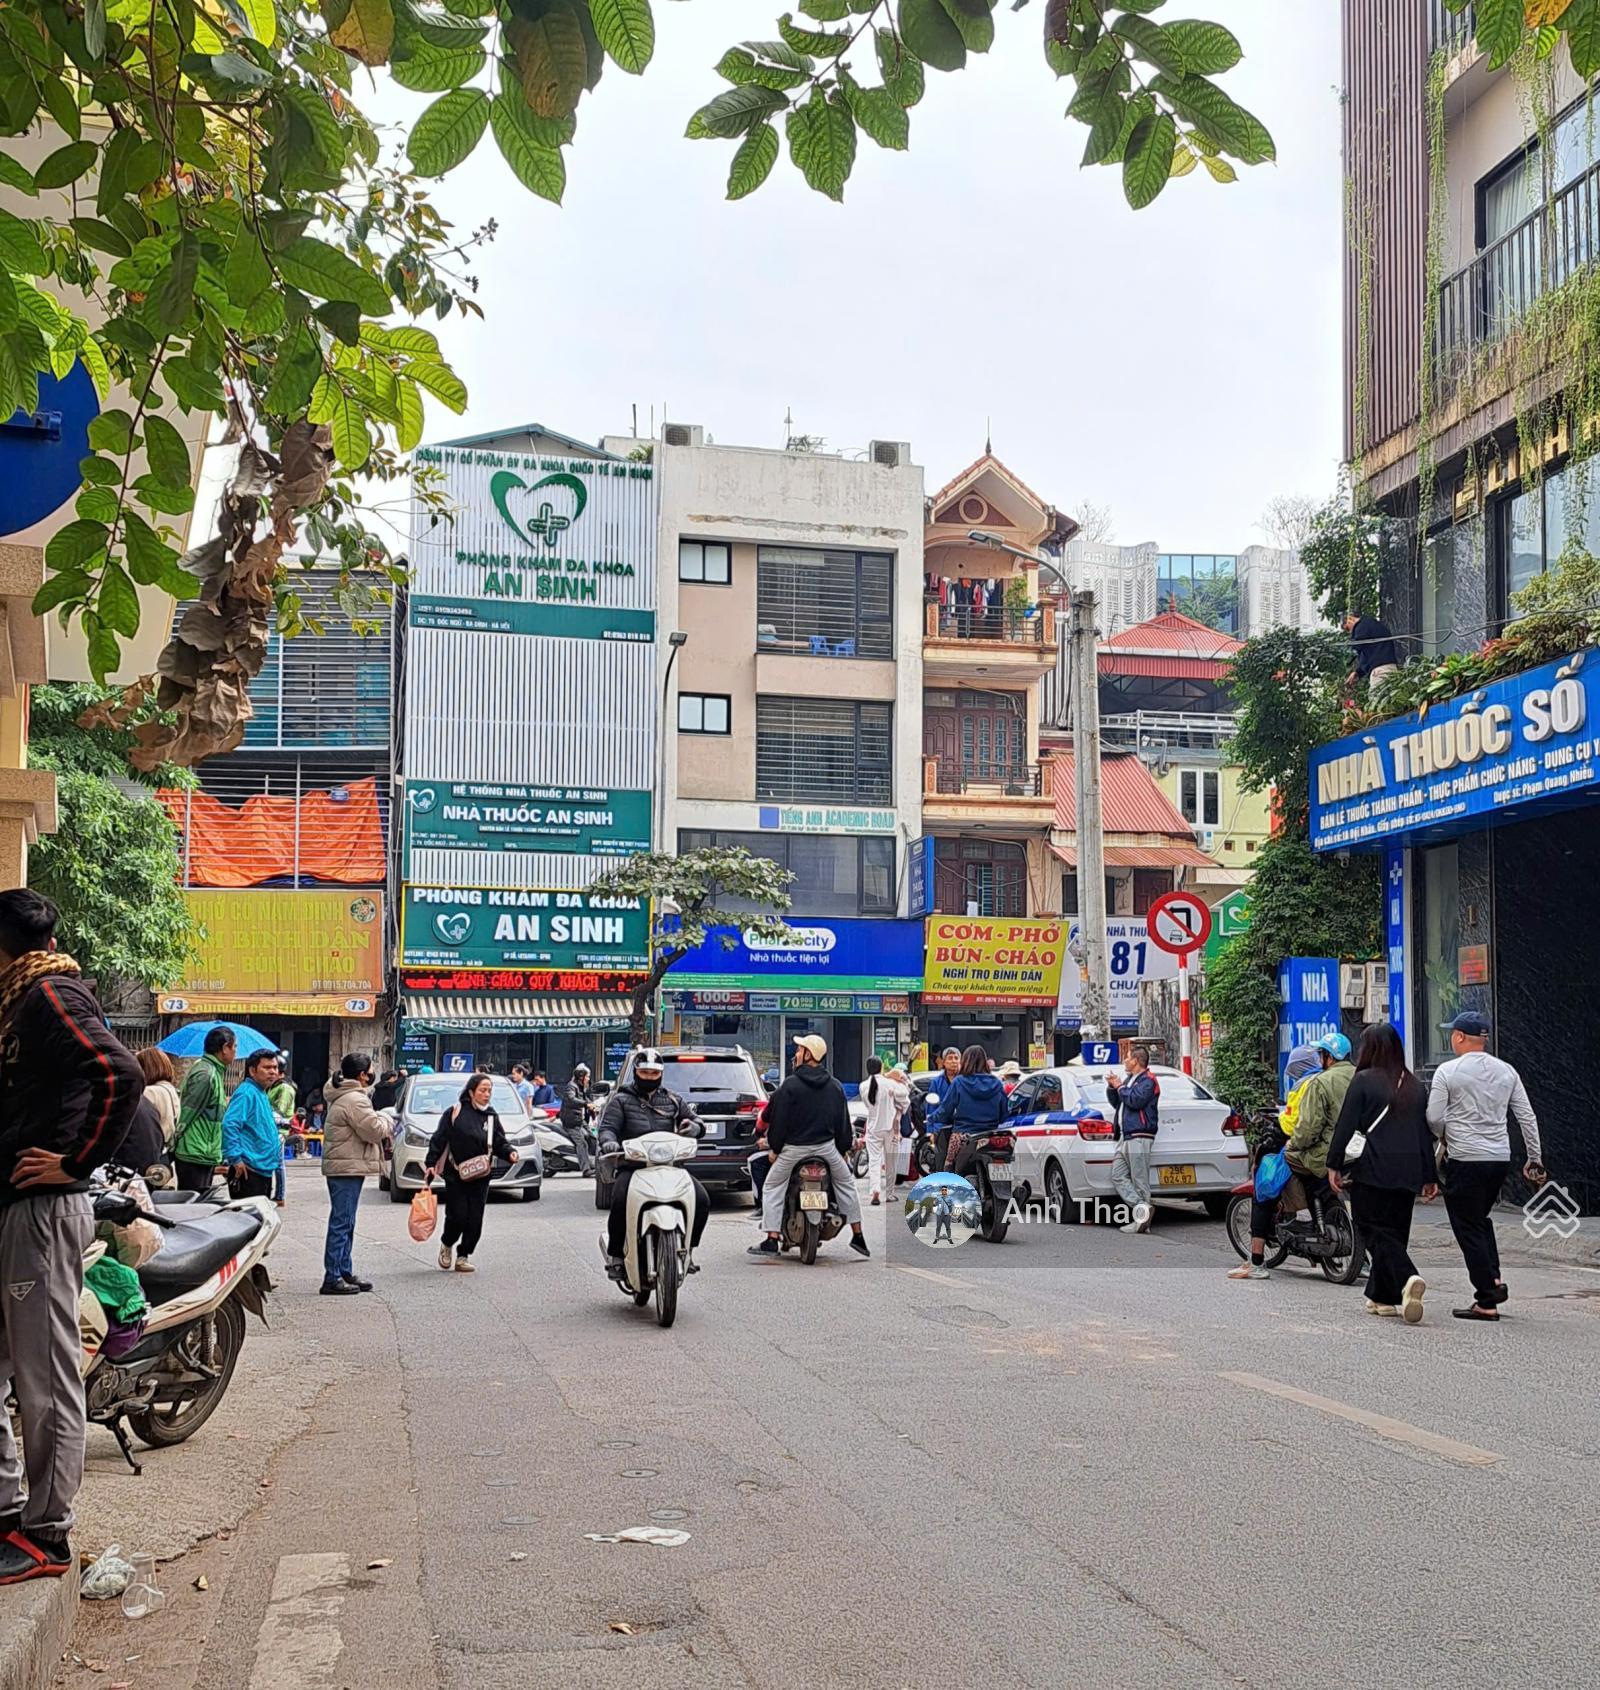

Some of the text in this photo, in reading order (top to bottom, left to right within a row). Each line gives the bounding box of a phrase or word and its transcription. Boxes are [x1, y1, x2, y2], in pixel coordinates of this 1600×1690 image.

[592, 561, 635, 577] KHOA
[483, 572, 597, 601] AN SINH
[1317, 653, 1586, 805] NHÀ THUỐC SỐ
[453, 784, 607, 800] HỆ THỐNG NHÀ THUỐC AN SINH
[1320, 811, 1335, 830] BÁN
[1336, 805, 1345, 825] LẺ
[1346, 799, 1370, 822] THUỐC
[1371, 795, 1398, 816] THÀNH
[1398, 785, 1424, 809] PHẨM
[1428, 779, 1451, 803] THỰC
[1452, 768, 1479, 797] PHẨM
[1480, 762, 1505, 787] CHỨC
[1508, 757, 1536, 780] NĂNG
[1544, 746, 1574, 772] DỤNG
[1575, 742, 1590, 763] CỤ
[1522, 781, 1543, 796] Phạm
[1544, 775, 1568, 791] Quang
[443, 803, 613, 826] NHÀ THUỐC AN SINH
[806, 811, 823, 826] ANH
[825, 809, 870, 827] ACADEMIC
[871, 812, 895, 828] ROAD
[413, 884, 482, 905] PHÒNG
[488, 888, 549, 908] KHÁM
[556, 893, 583, 908] ĐA
[233, 924, 302, 949] BÌNH
[310, 924, 371, 949] DÂN
[494, 914, 624, 943] AN SINH
[938, 923, 993, 942] CƠM
[1008, 923, 1060, 943] PHỞ
[1107, 925, 1148, 937] NHÀ THU
[750, 952, 830, 965] Nhà thuốc tiện lợi
[935, 944, 982, 963] BÚN
[994, 947, 1056, 966] CHÁO
[1110, 941, 1147, 975] 81
[971, 969, 990, 981] TRỌ
[993, 968, 1018, 980] BÌNH
[970, 982, 994, 991] khách
[996, 985, 1016, 993] ngon
[1018, 985, 1045, 994] miệng
[1302, 966, 1329, 1003] NHÀ
[168, 999, 184, 1010] 73
[350, 1000, 366, 1011] 73
[783, 997, 800, 1008] 70
[820, 997, 837, 1008] 40
[858, 1001, 870, 1010] 10
[884, 1003, 909, 1013] 40%
[430, 1018, 480, 1028] PHÒNG
[483, 1018, 524, 1027] KHÁM
[527, 1018, 546, 1027] ĐA
[548, 1018, 585, 1027] KHOA
[590, 1018, 609, 1027] AN
[1093, 1044, 1111, 1062] G7
[1169, 1166, 1185, 1175] 29E
